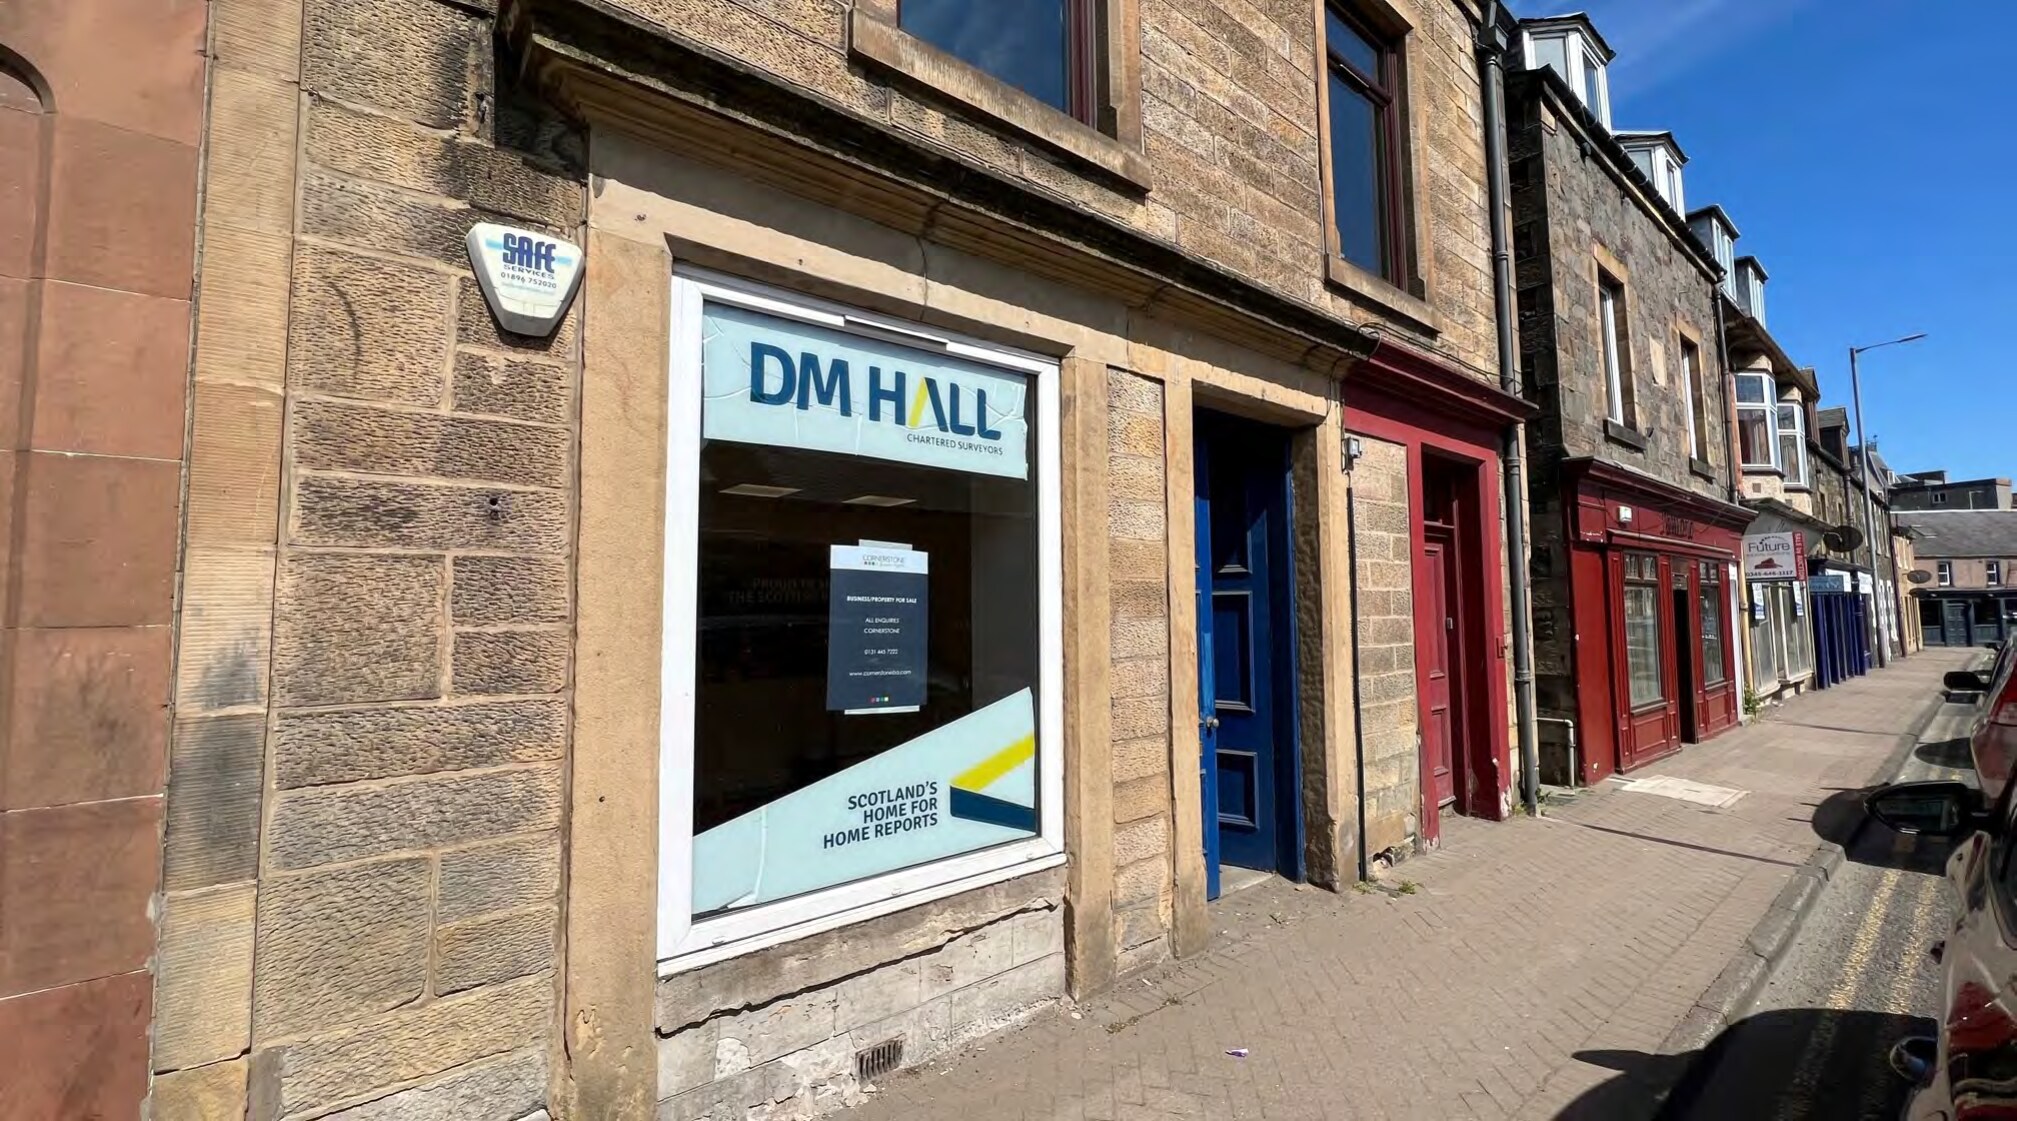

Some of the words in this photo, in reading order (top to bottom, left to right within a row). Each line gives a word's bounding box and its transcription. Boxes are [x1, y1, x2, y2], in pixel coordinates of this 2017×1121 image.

[503, 233, 556, 273] SAFE
[500, 271, 526, 284] 01896
[528, 277, 557, 289] 752020
[503, 263, 555, 280] SERVICES
[750, 341, 852, 417] DM
[869, 365, 1002, 440] HALL
[906, 433, 957, 449] CHARTERED
[957, 440, 1004, 456] SURVEYORS
[862, 553, 905, 564] CORNERSTONE
[1747, 542, 1791, 553] Future
[846, 595, 896, 603] BUSINESS/PROPERTY
[848, 781, 938, 810] SCOTLAND'S
[863, 803, 907, 824] HOME
[911, 797, 938, 815] FOR
[823, 826, 870, 849] HOME
[874, 812, 938, 838] REPORTS
